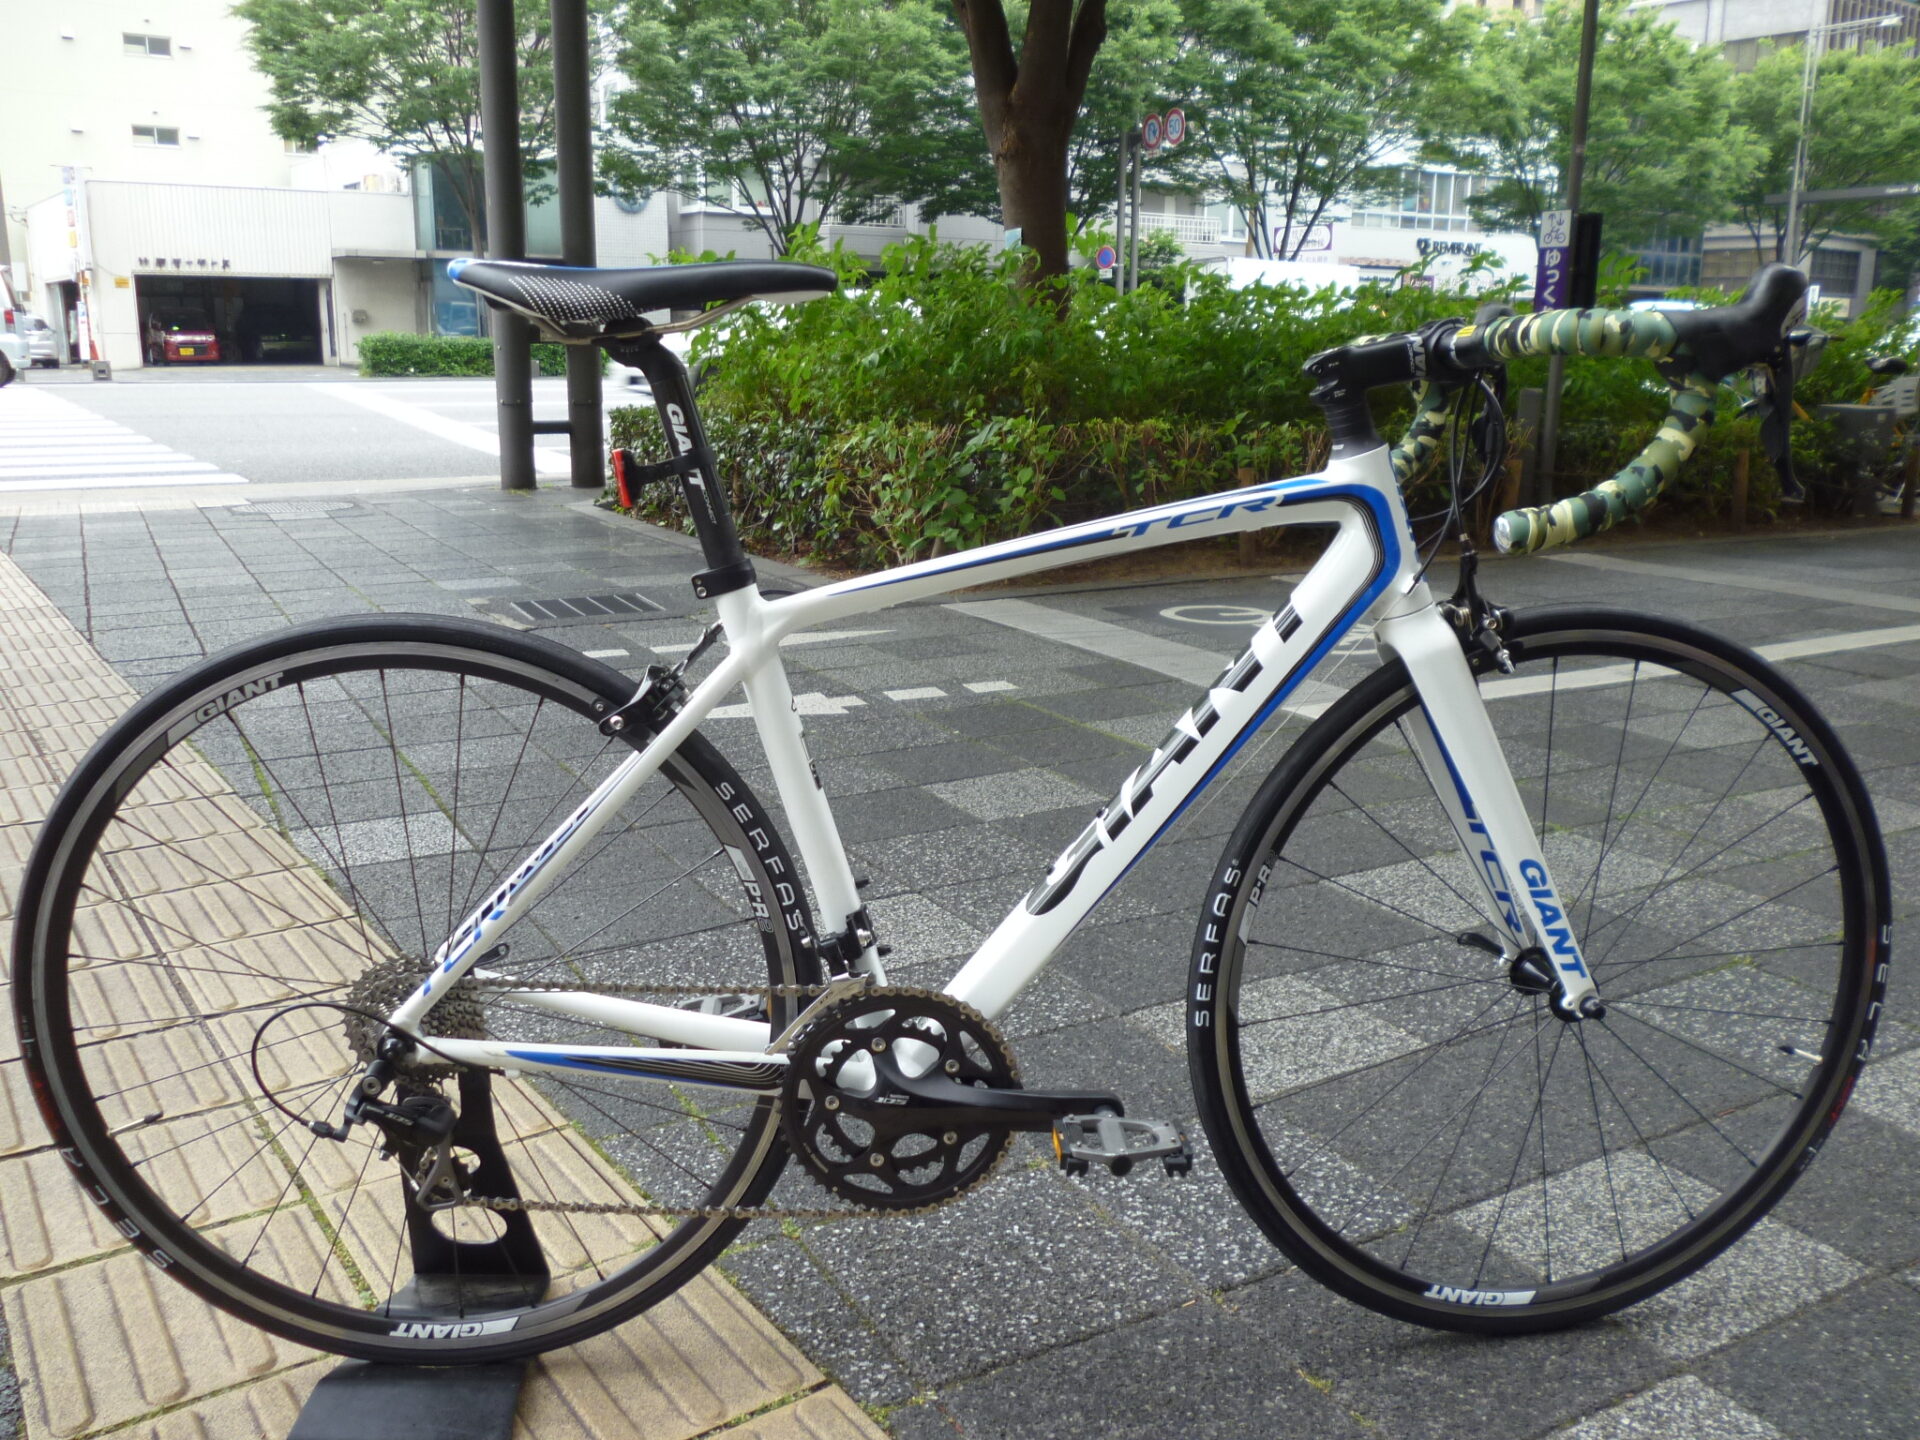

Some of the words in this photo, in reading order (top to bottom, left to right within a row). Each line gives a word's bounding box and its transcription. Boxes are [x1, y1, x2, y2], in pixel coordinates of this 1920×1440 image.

[1169, 118, 1181, 135] 50
[666, 403, 706, 491] GIAT
[1119, 496, 1276, 538] TCR
[195, 671, 284, 724] GIANT
[1756, 706, 1819, 765] GIANT
[714, 781, 805, 931] SERFAS
[1195, 865, 1241, 1028] SERFAS
[1519, 858, 1587, 979] GIANT
[1424, 1284, 1505, 1306] GIANT
[389, 1321, 484, 1340] GIANT
